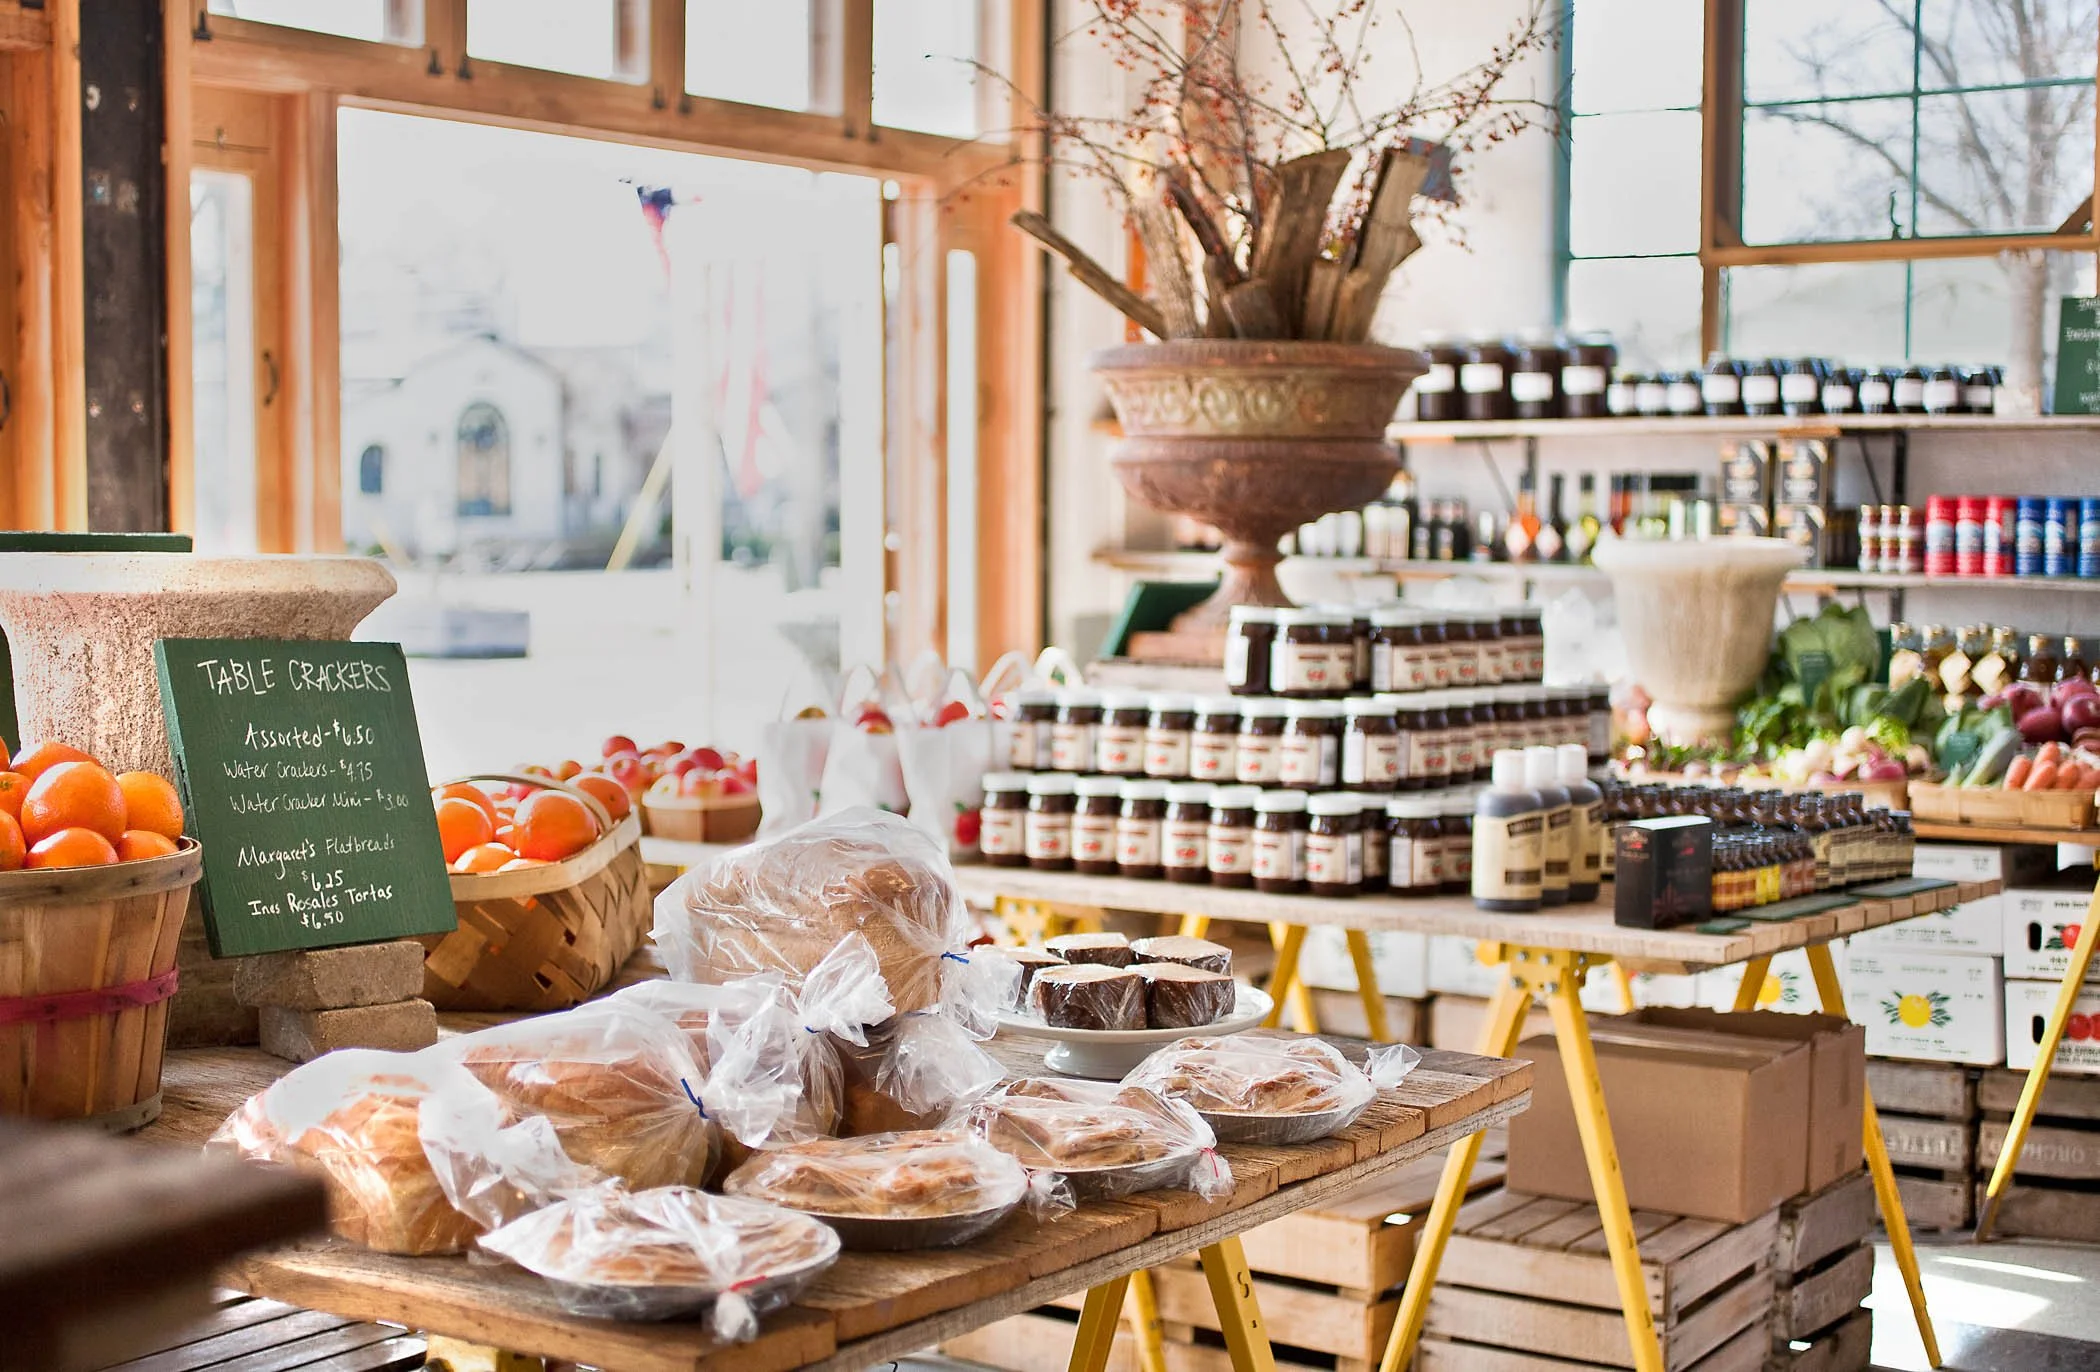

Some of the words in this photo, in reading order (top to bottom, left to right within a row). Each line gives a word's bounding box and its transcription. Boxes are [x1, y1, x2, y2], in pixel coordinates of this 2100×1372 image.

[197, 658, 275, 695] TABLE
[288, 659, 391, 692] CRACKERS
[224, 760, 269, 779] Water
[230, 793, 279, 814] Water
[283, 793, 326, 811] Cracker
[238, 838, 316, 880] Margaret's
[325, 833, 395, 855] Flatbreads
[301, 870, 344, 892] $6.25
[248, 900, 281, 916] Ines
[287, 891, 339, 913] Rosales
[344, 884, 393, 904] Tortas
[301, 911, 344, 929] $6.50
